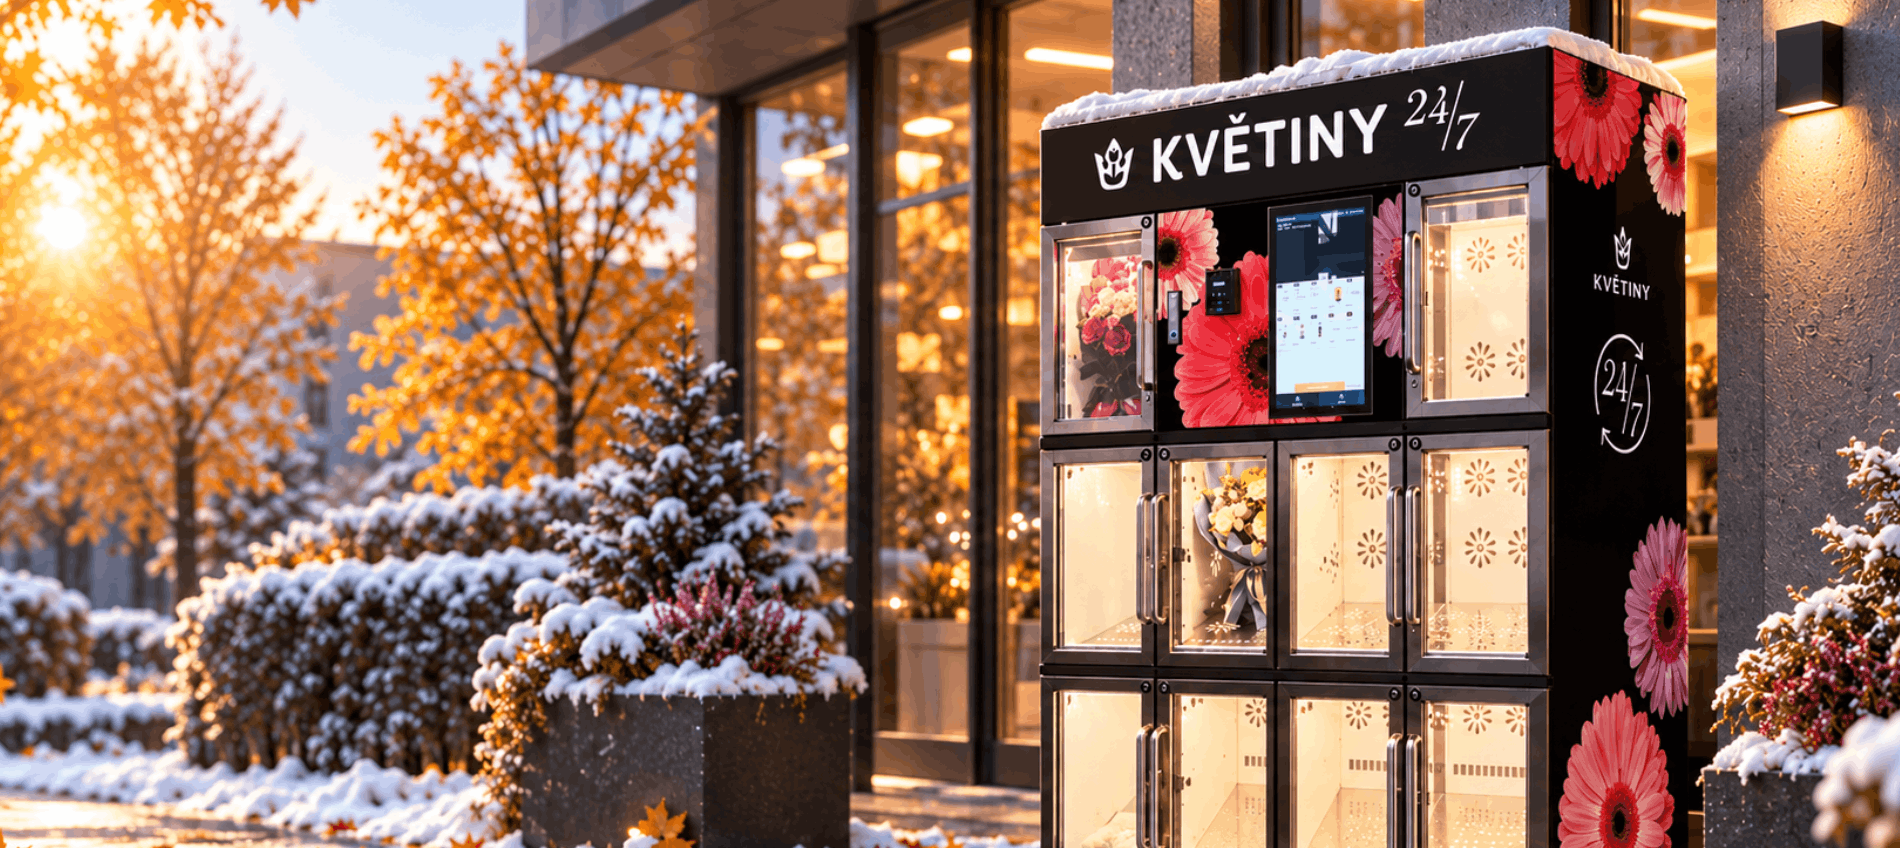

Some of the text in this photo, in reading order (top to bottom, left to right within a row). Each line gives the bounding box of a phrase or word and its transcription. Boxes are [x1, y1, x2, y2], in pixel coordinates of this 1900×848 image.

[1152, 80, 1481, 182] KVĚTINY 24/7
[1593, 273, 1650, 300] KVĚTINY
[1601, 358, 1643, 437] 24/7
